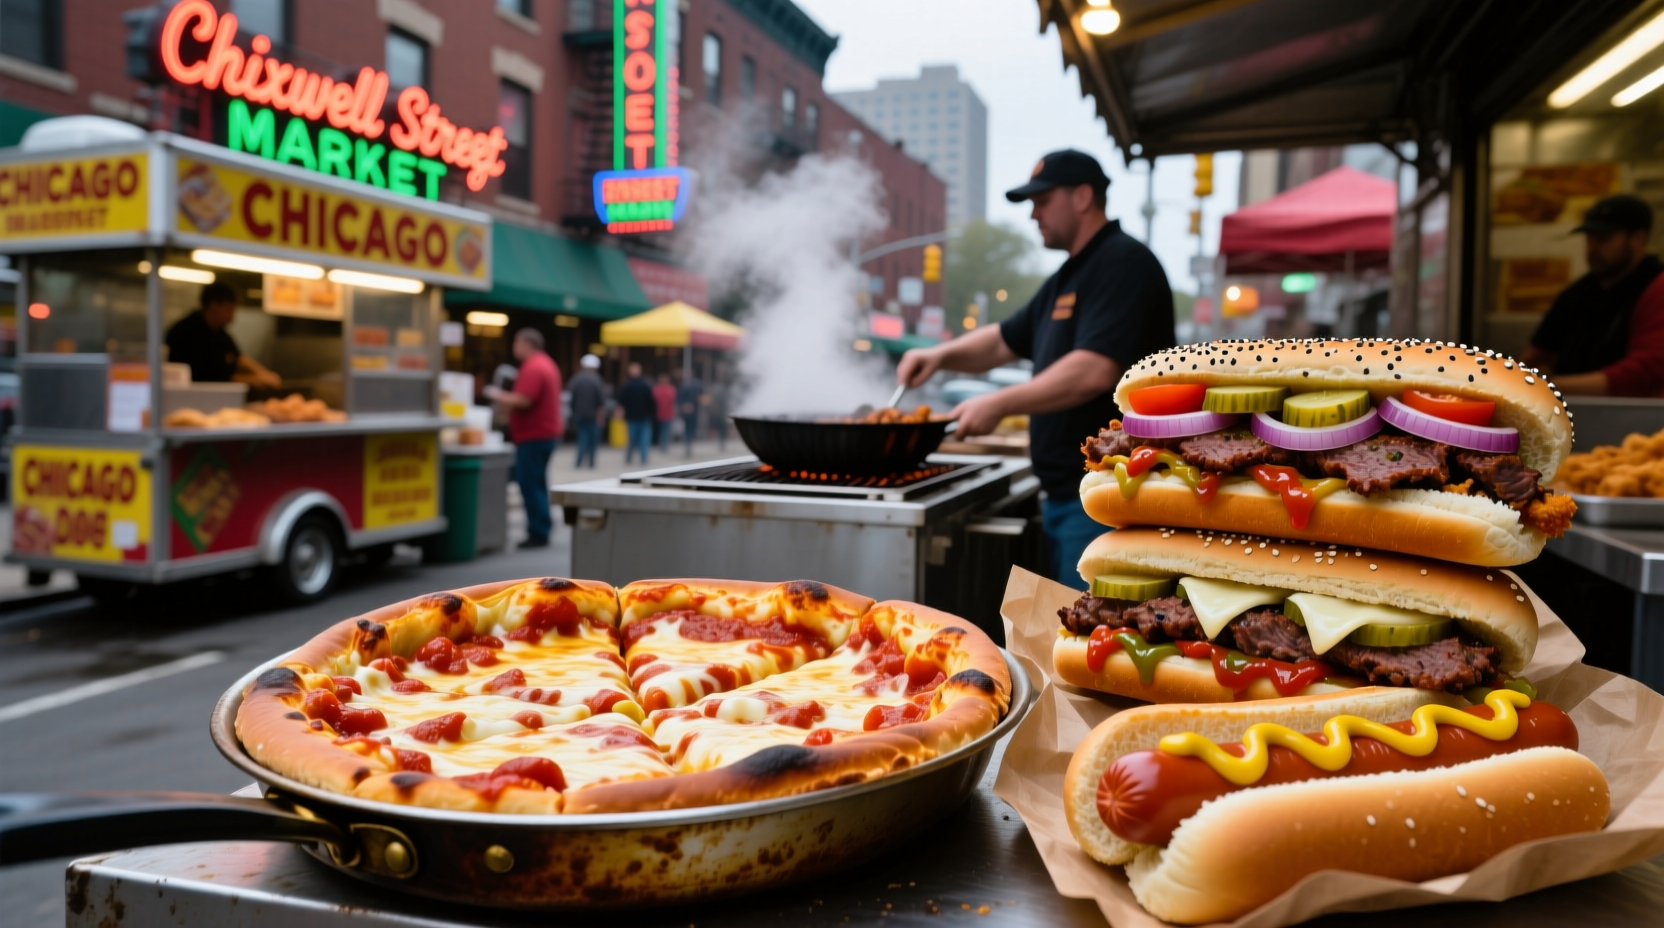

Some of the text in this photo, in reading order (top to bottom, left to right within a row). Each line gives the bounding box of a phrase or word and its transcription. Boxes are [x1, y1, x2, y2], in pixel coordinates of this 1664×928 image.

[161, 0, 389, 138] Chixwell
[228, 99, 447, 202] MARKET
[242, 182, 447, 269] CHICAGO
[23, 459, 136, 503] CHICAGO
